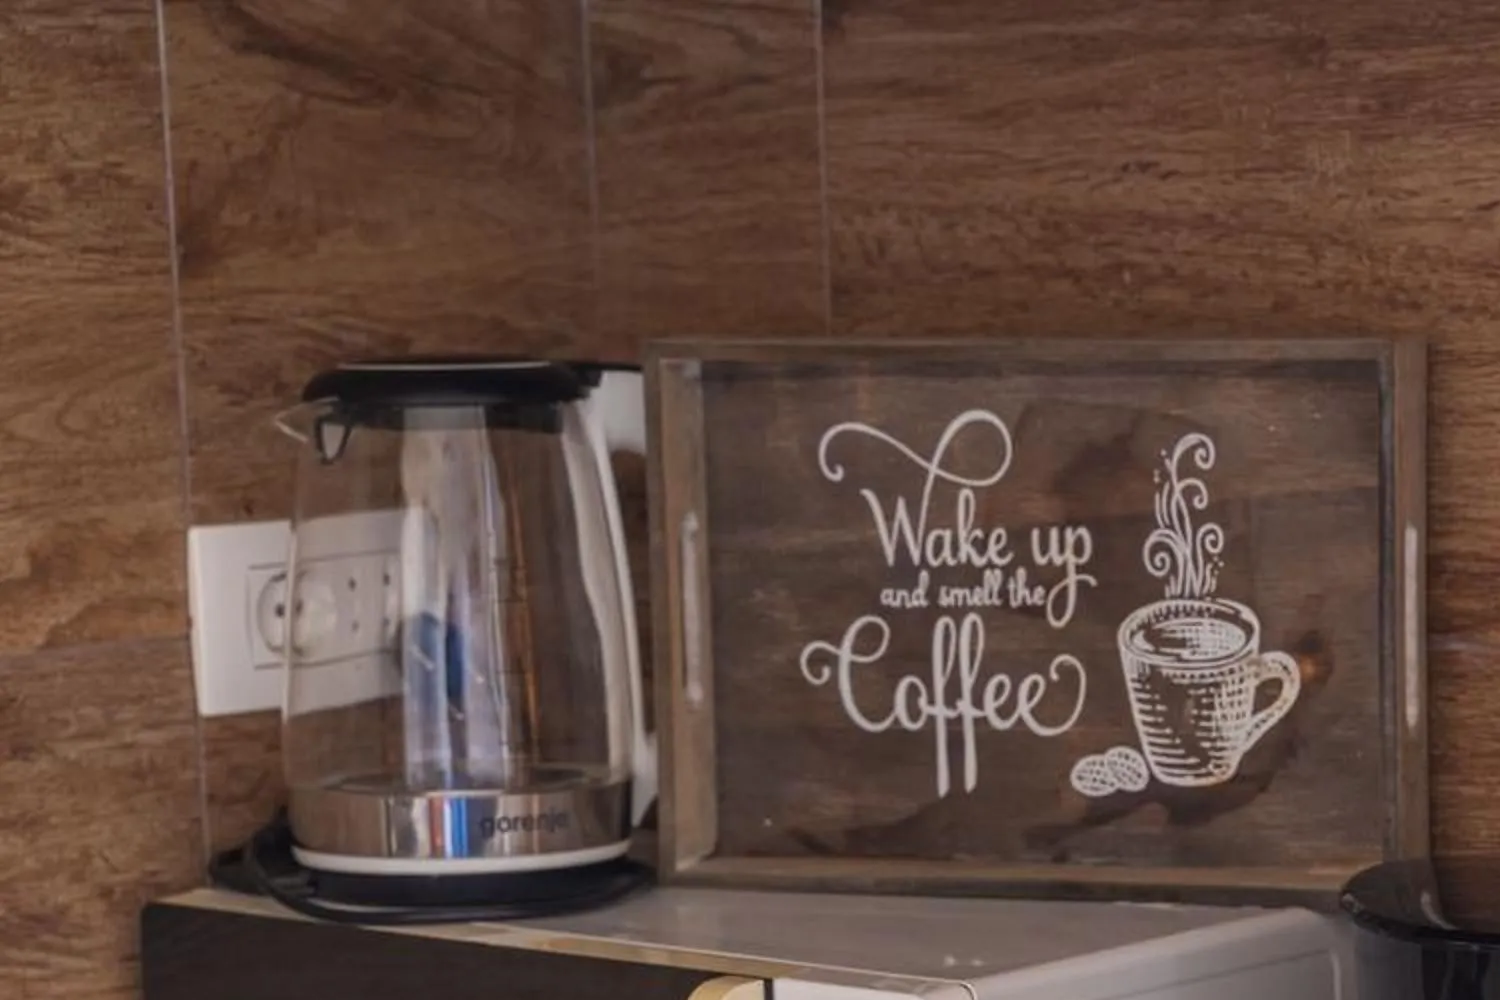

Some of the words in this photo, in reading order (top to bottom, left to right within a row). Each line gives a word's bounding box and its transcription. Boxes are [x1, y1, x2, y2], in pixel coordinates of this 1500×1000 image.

[819, 409, 1014, 567] Wake
[1031, 524, 1097, 628] up
[880, 570, 929, 608] and
[937, 569, 1001, 608] smell
[1008, 566, 1046, 608] the
[800, 613, 1087, 798] Coffee
[479, 805, 570, 839] gorenje
